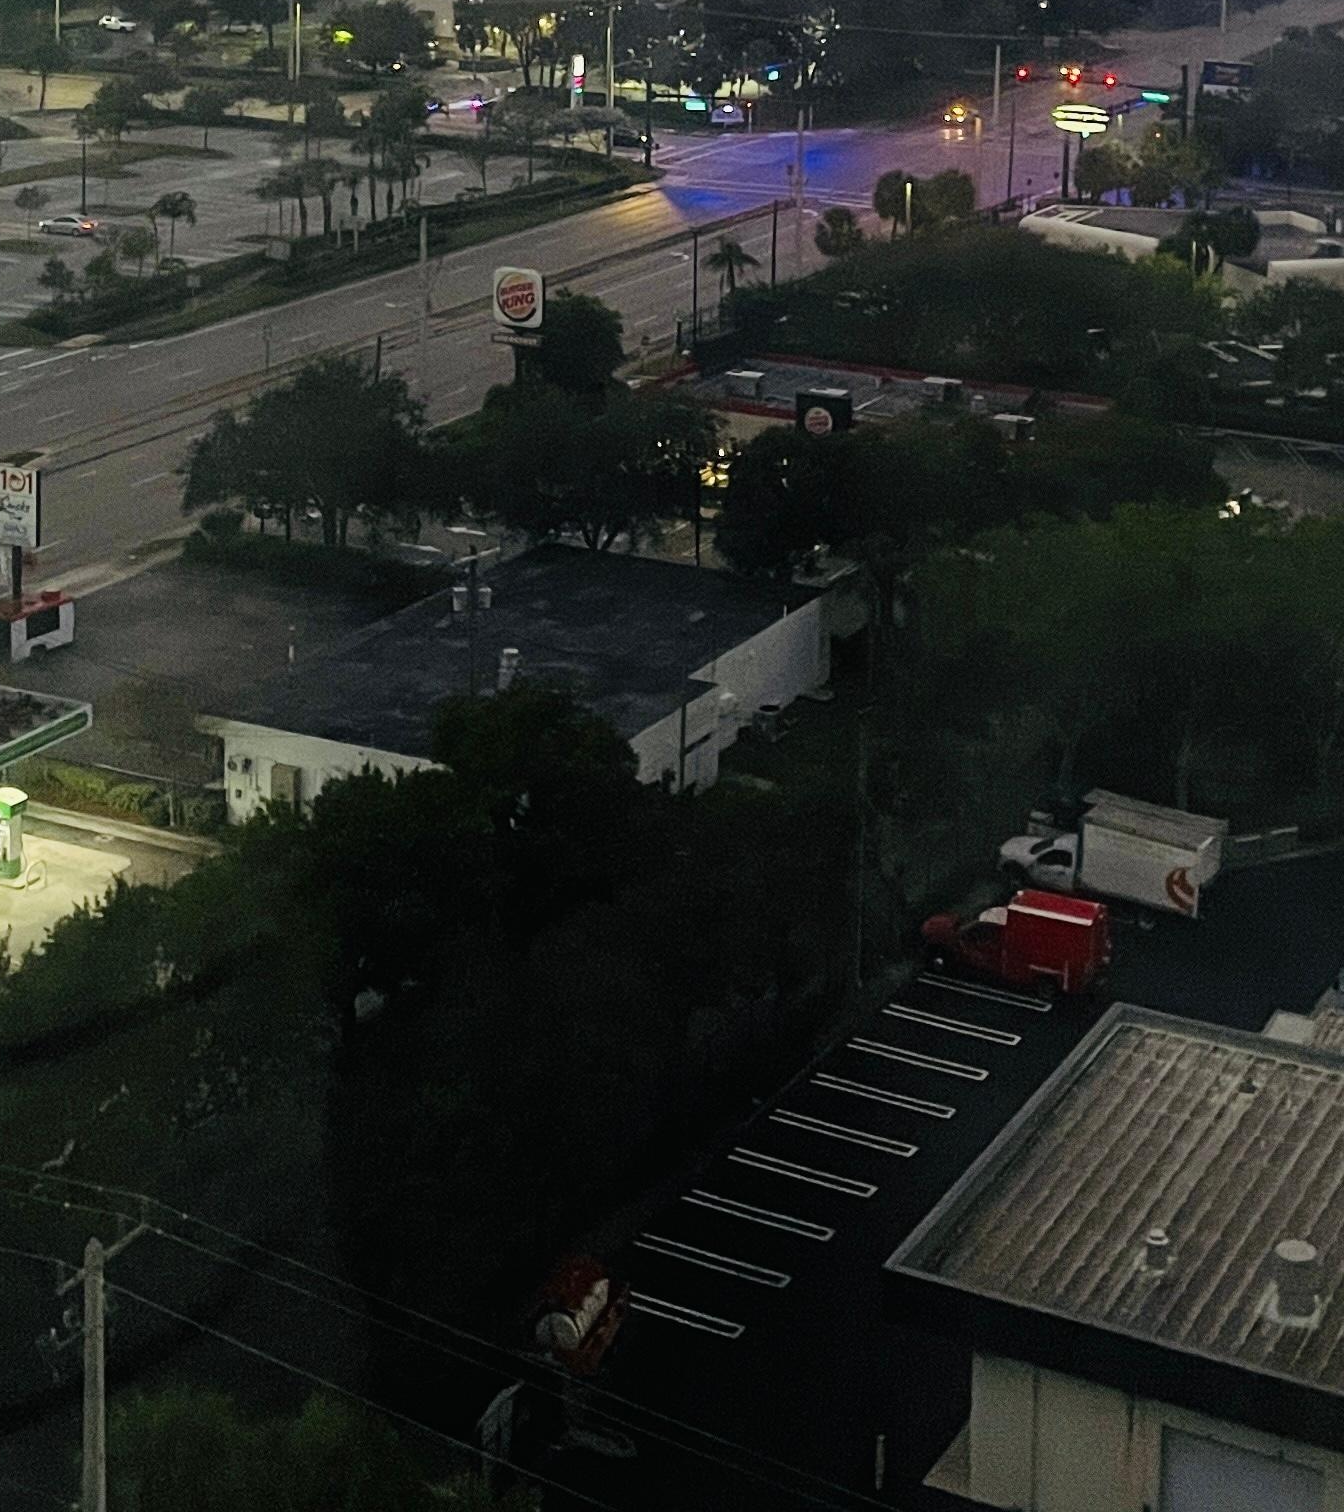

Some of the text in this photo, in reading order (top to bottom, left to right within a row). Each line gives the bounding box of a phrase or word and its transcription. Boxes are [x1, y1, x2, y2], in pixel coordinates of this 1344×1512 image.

[500, 282, 534, 297] BURGER
[501, 292, 535, 309] KING
[0, 468, 32, 495] 101
